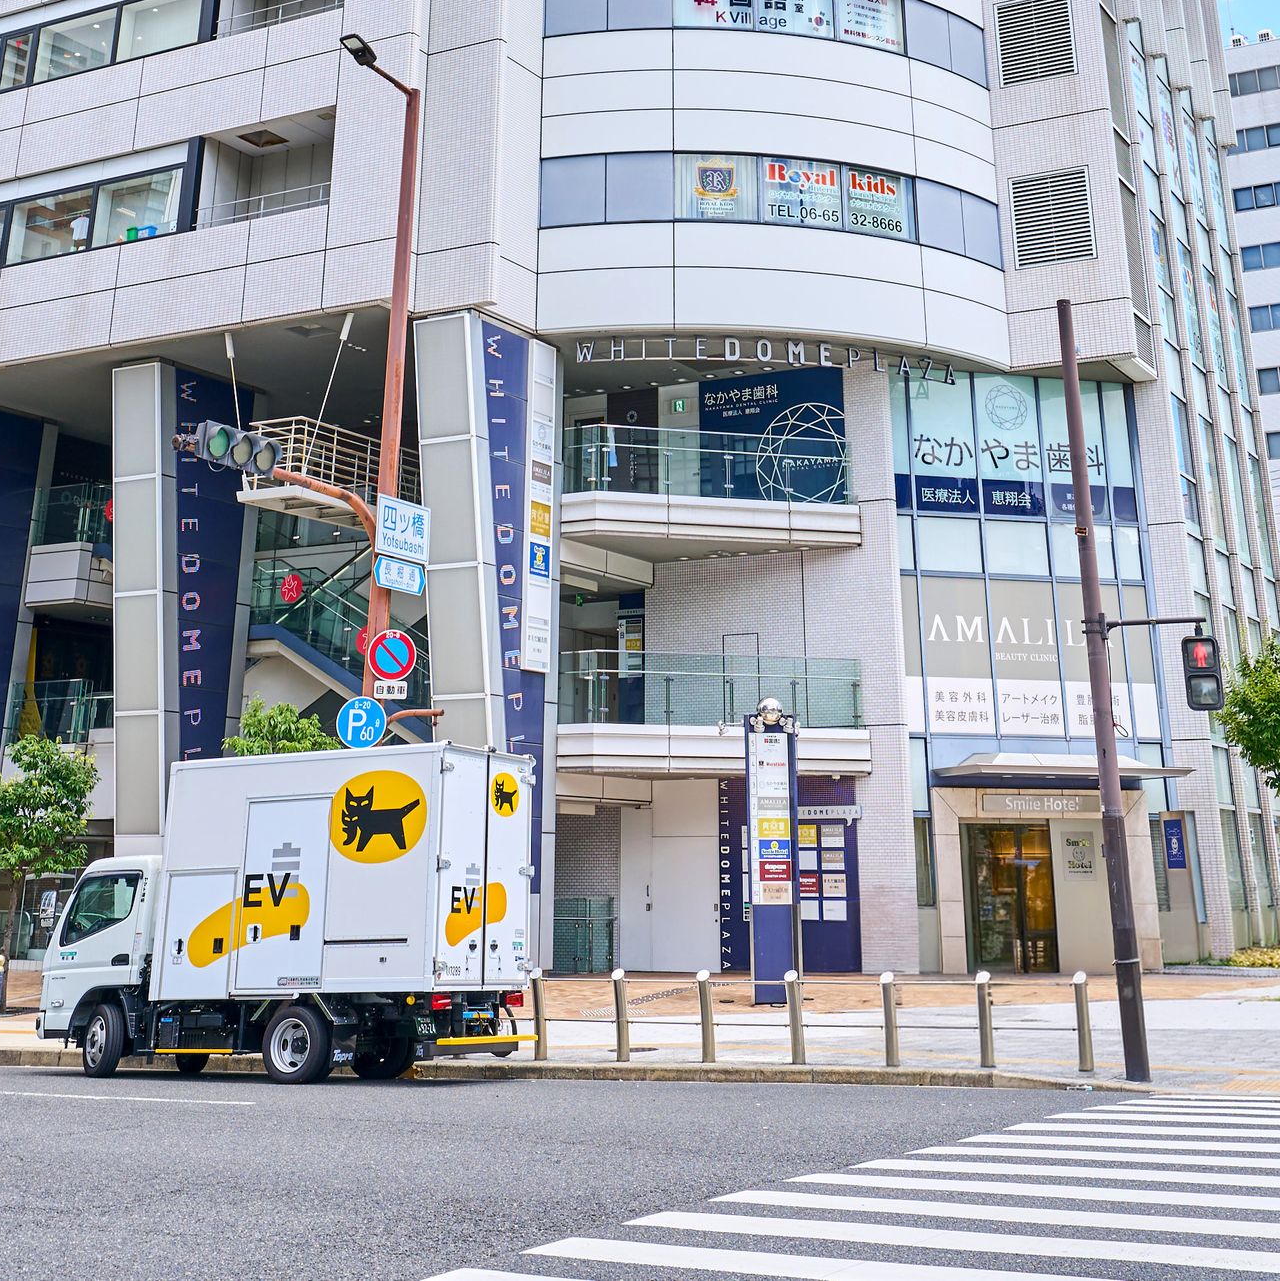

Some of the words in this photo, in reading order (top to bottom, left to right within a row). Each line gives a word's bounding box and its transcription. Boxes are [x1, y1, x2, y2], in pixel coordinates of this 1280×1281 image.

[716, 11, 726, 23] K
[767, 163, 836, 189] Royal
[850, 172, 896, 197] kids
[704, 384, 779, 406] なかやま歯科
[921, 488, 976, 505] 医療法人
[991, 490, 1032, 507] 恵翔会
[383, 504, 425, 540] 四ツ橋
[382, 531, 425, 556] Yotsubashi
[384, 562, 416, 583] 長堀通
[386, 631, 401, 639] 20-8
[928, 614, 1115, 650] AMALIL
[995, 653, 1028, 661] BEAUTY
[1030, 653, 1058, 662] CLINIC
[375, 685, 406, 696] 自動車
[935, 691, 987, 704] 美容外科
[354, 701, 371, 709] 8-20
[1002, 693, 1059, 705] アートメイク
[935, 710, 989, 723] 美容皮膚科
[1002, 712, 1060, 725] レーザー治療
[347, 709, 367, 741] P
[360, 726, 374, 741] 60
[1068, 861, 1093, 869] Hotel
[243, 872, 291, 908] EV
[451, 885, 476, 914] EV
[333, 1049, 354, 1063] Topre
